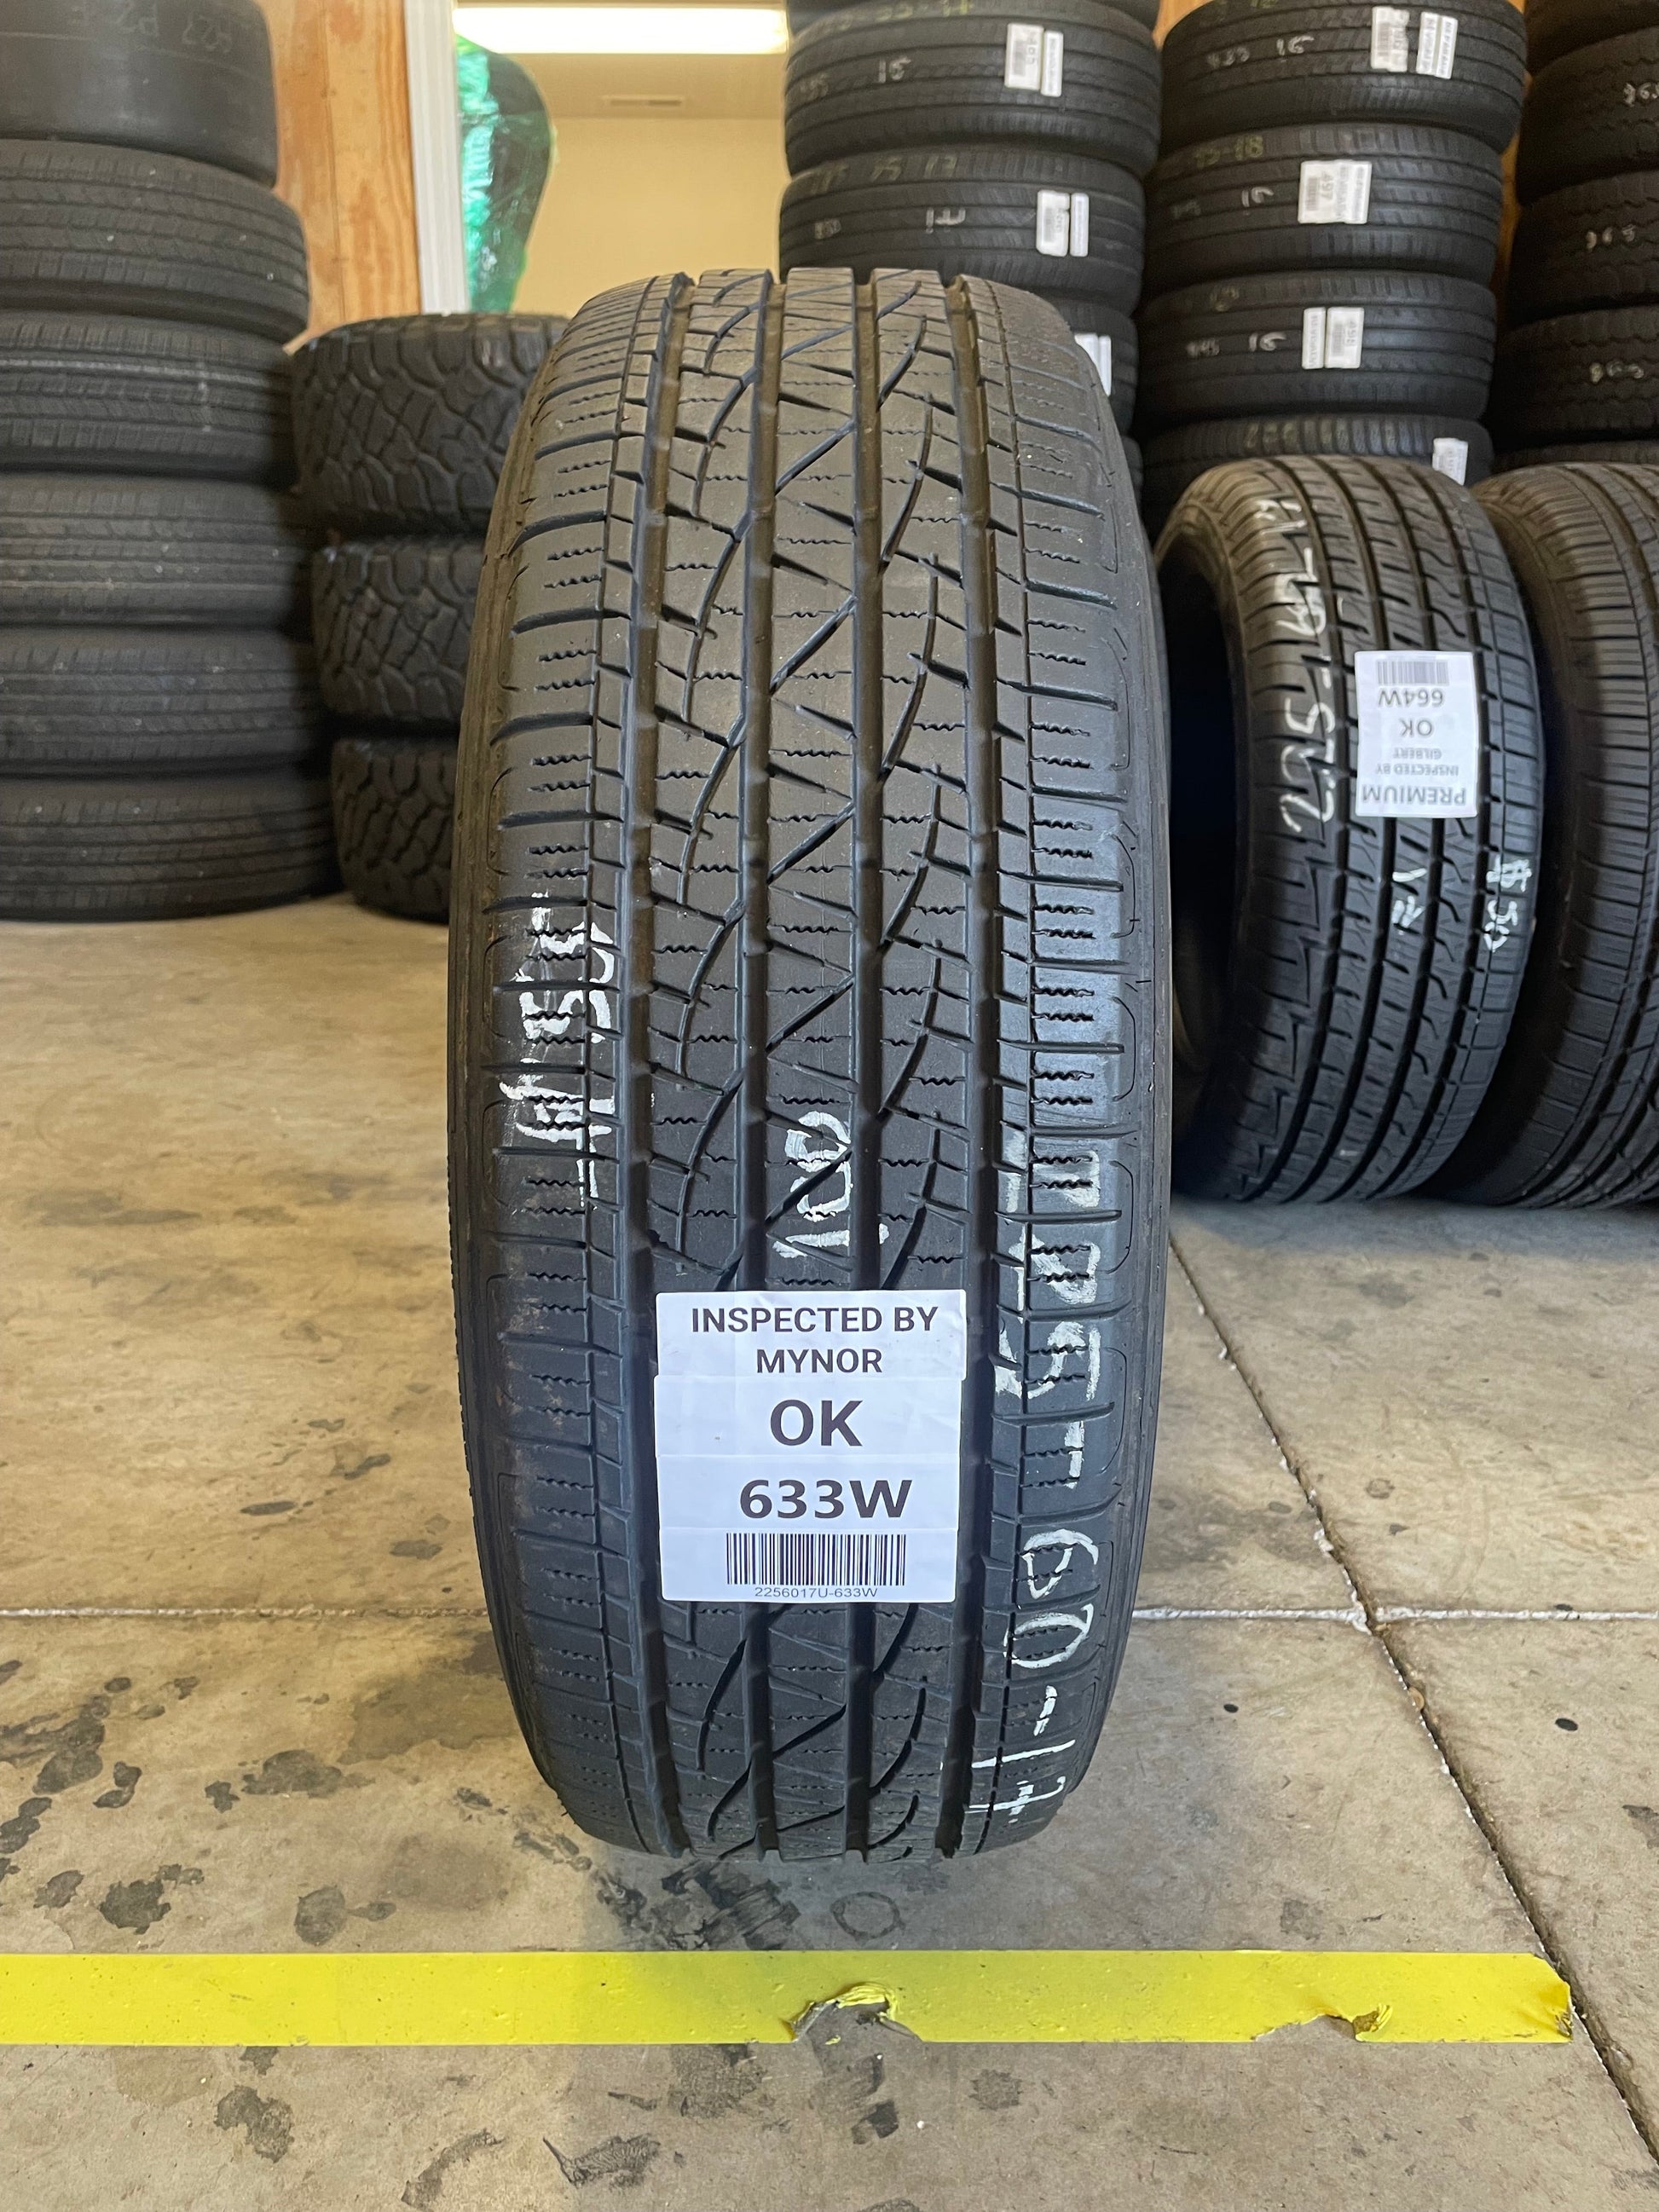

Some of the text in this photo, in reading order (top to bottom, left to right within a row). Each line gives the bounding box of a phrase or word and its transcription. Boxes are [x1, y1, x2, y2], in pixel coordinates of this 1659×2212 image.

[1378, 689, 1444, 708] 664W
[1399, 718, 1434, 738] OK
[1392, 748, 1442, 759] GILBERT
[1375, 764, 1459, 777] INSPECTED BY
[1362, 784, 1466, 806] PREMIUM
[691, 1306, 939, 1333] INSPECTED BY
[756, 1348, 883, 1373] MYNOR
[770, 1399, 864, 1447] OK
[739, 1479, 913, 1519] 633W
[754, 1585, 879, 1599] 2256017U-633W
